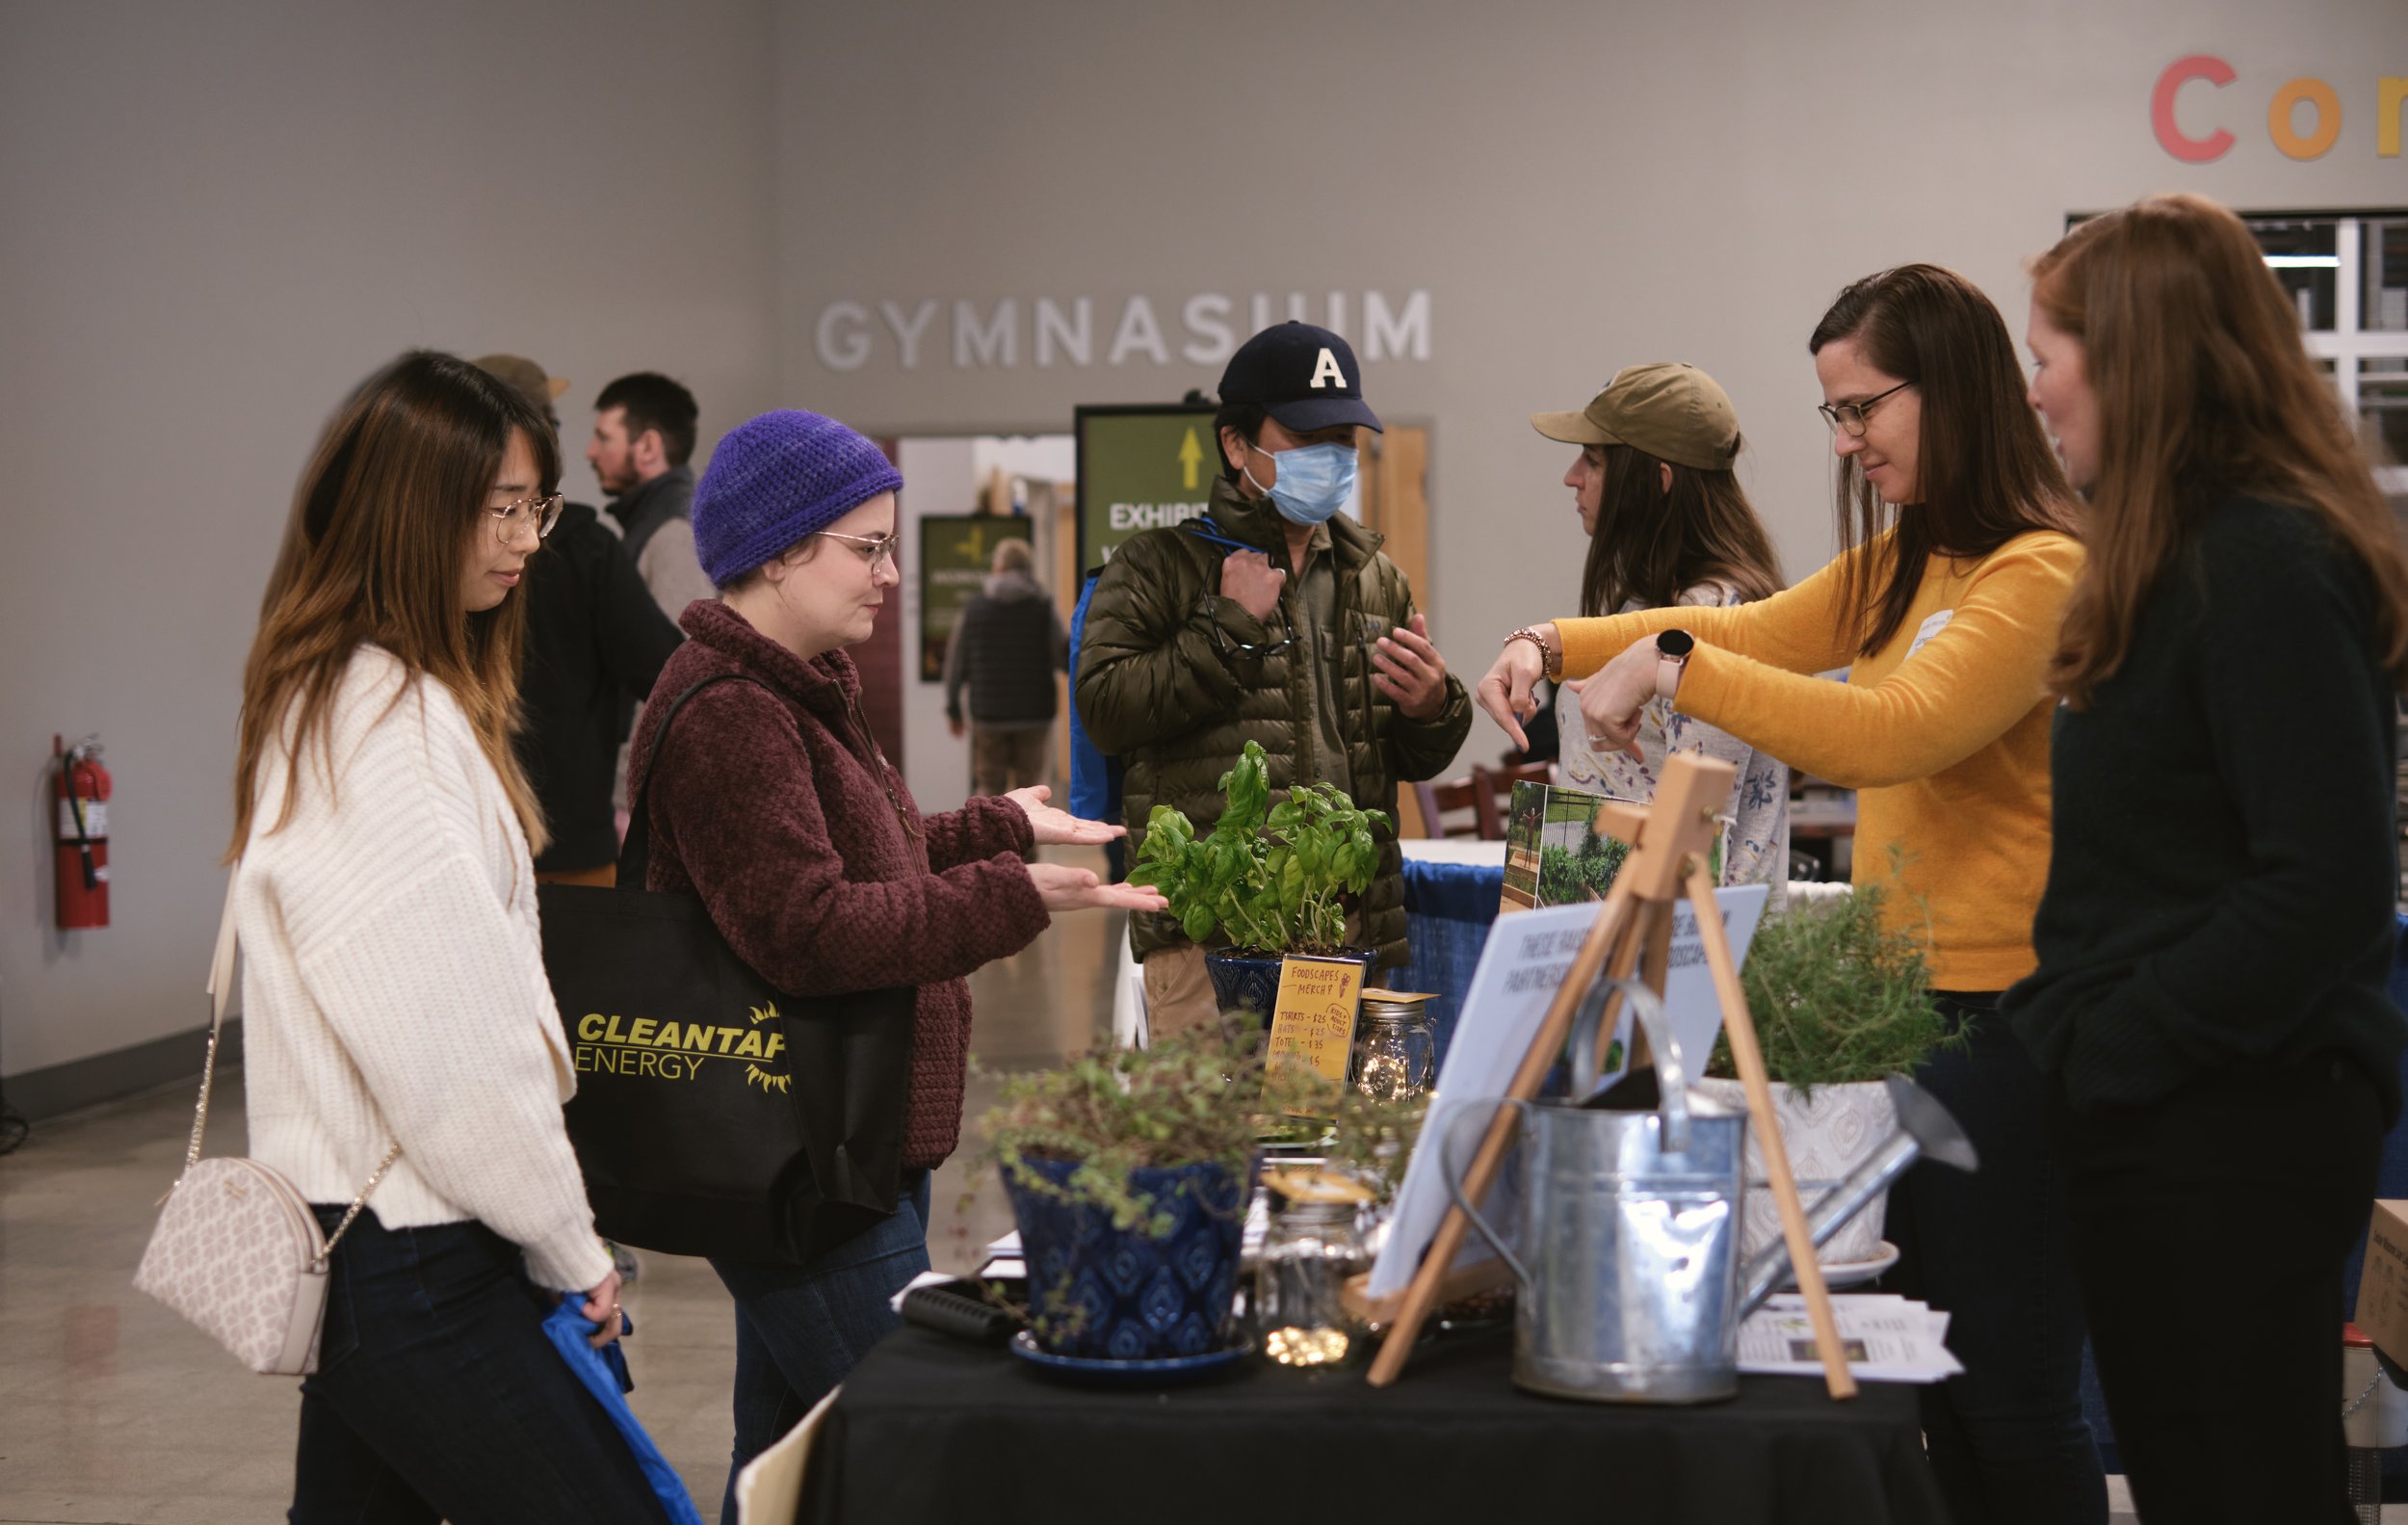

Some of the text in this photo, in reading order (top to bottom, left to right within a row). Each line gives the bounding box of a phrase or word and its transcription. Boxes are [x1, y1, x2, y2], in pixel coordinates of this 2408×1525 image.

[1310, 348, 1348, 388] A
[1292, 966, 1340, 982] FOODSCAPES
[1313, 1013, 1326, 1023] $25
[1277, 1024, 1295, 1034] HATS
[1310, 1027, 1325, 1038] $25
[1309, 1039, 1323, 1049] $35
[575, 1046, 705, 1081] ENERGY
